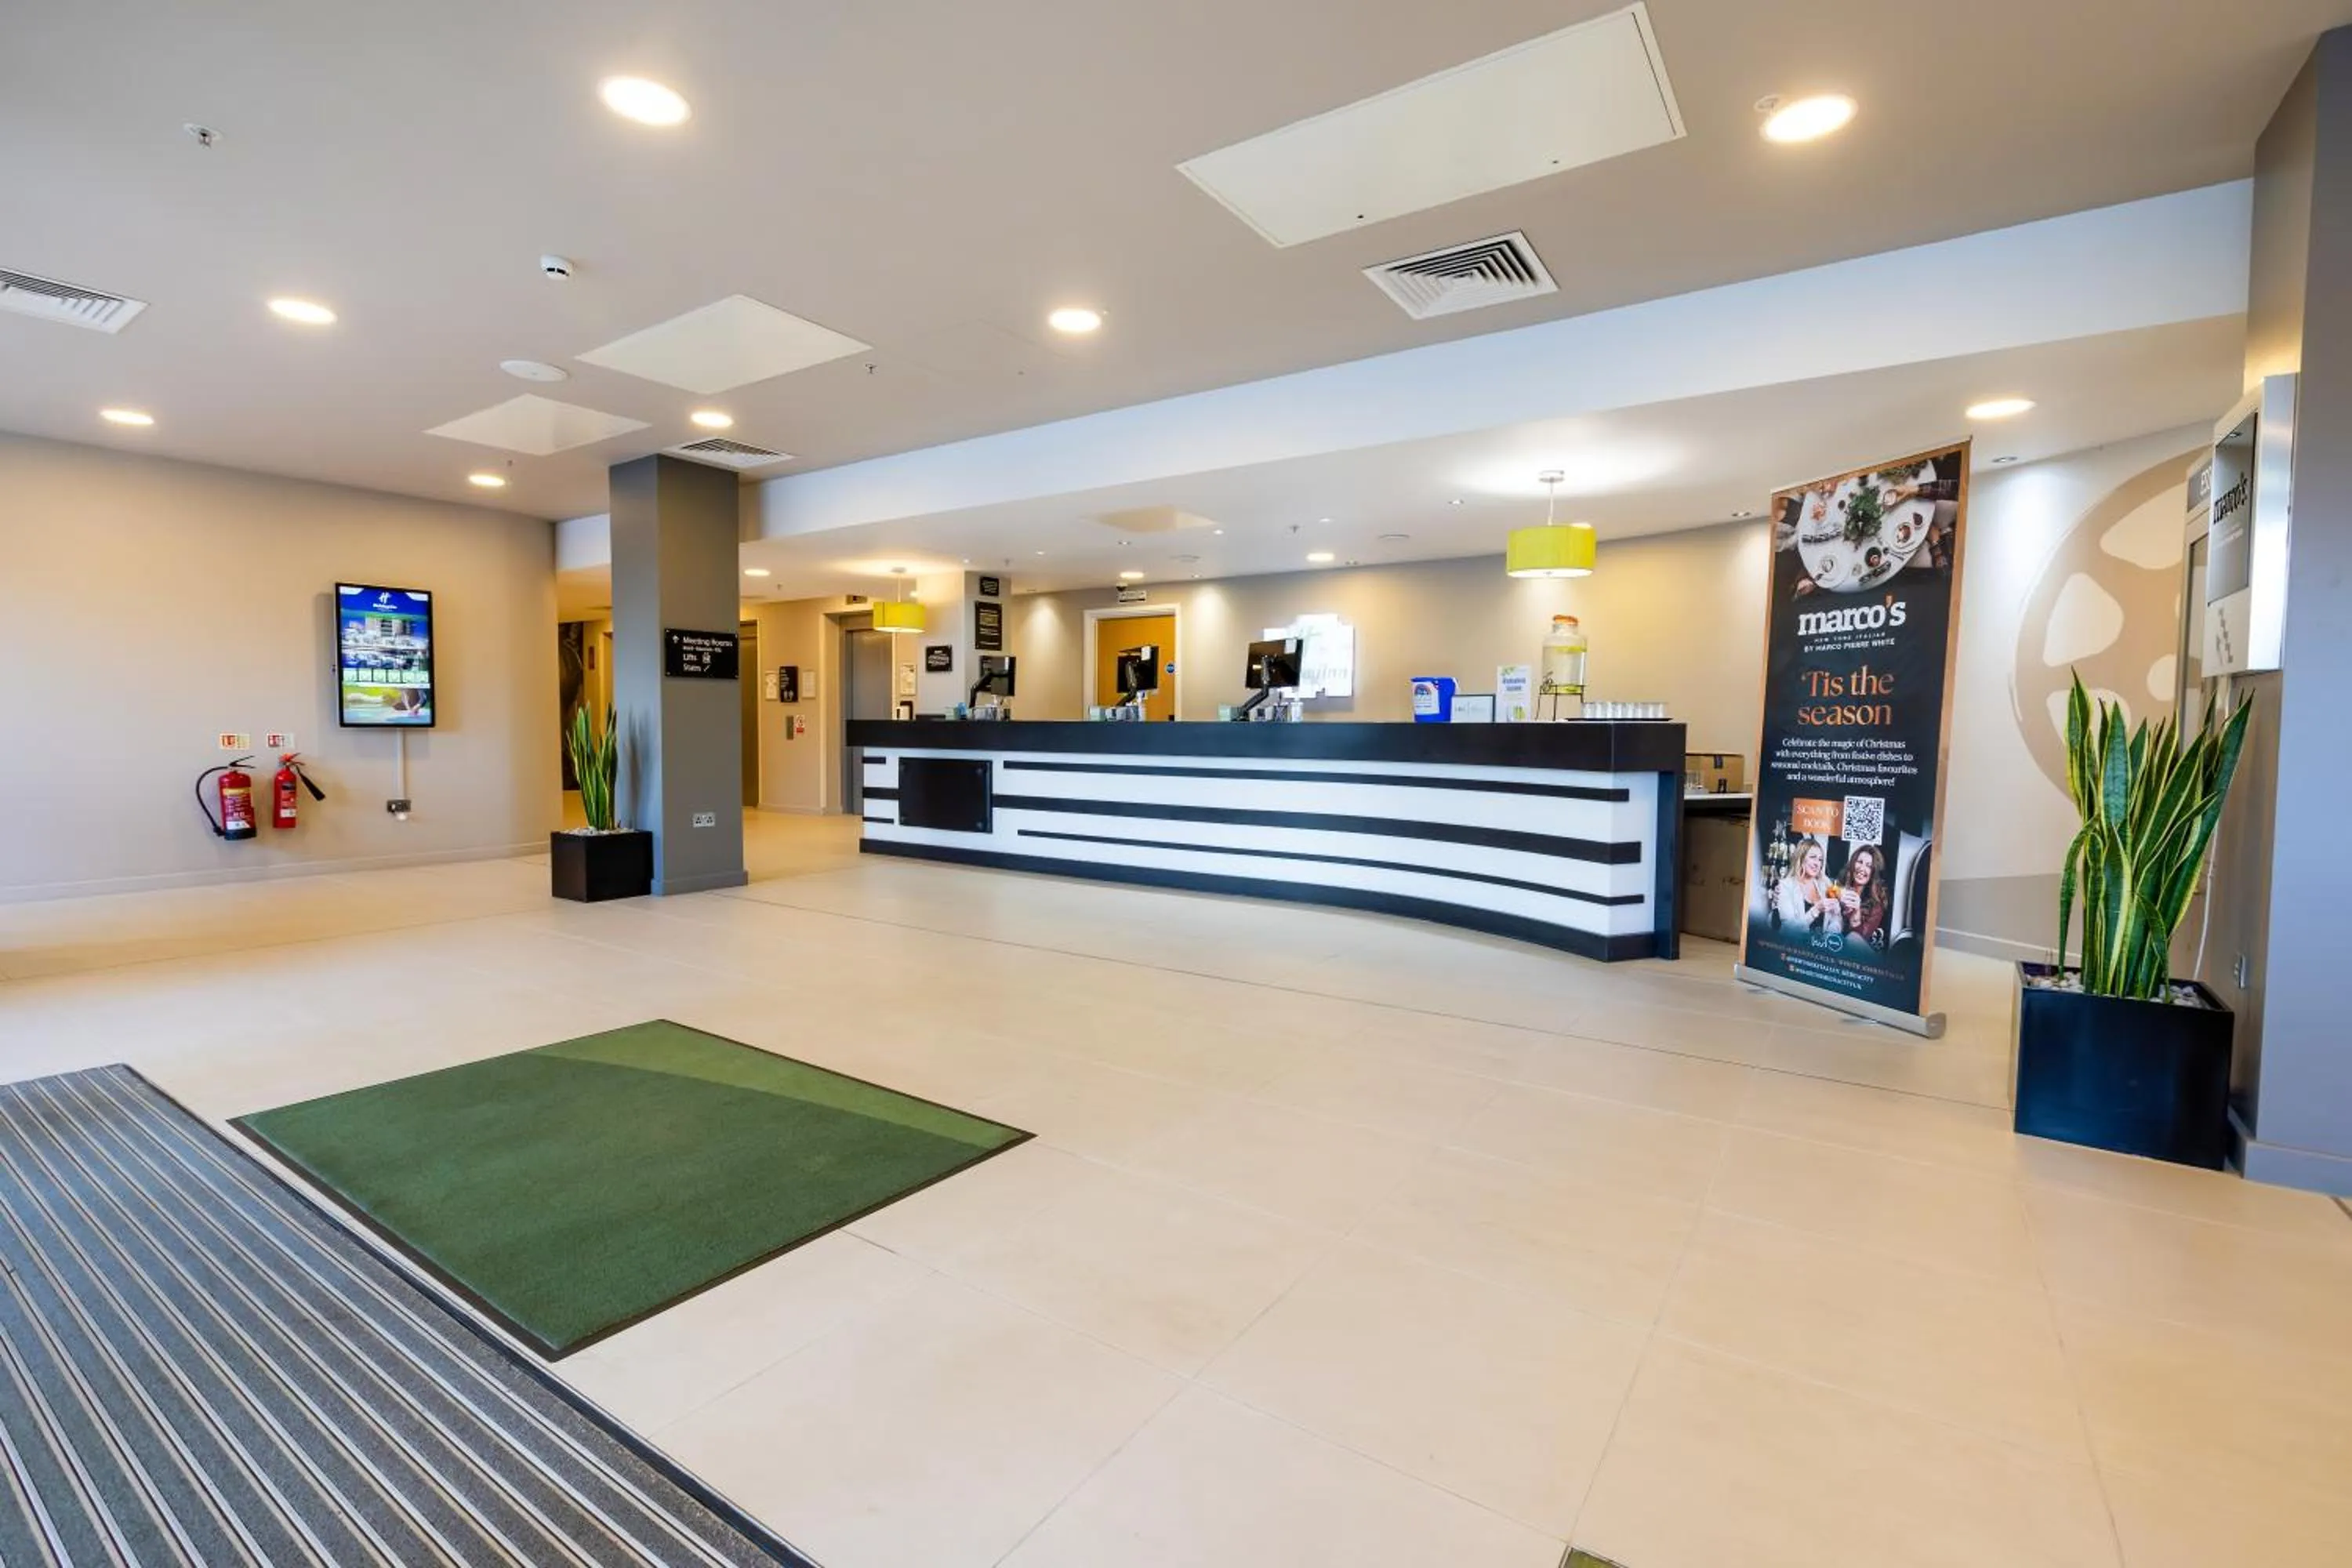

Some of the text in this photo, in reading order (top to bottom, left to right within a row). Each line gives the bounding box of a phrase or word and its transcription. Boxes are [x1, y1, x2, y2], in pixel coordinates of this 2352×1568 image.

[1798, 594, 1907, 636] marco's
[683, 636, 710, 647] Meeting
[1815, 643, 1842, 652] MARCO
[1843, 641, 1870, 650] PIERRE
[1850, 664, 1895, 696] the
[1798, 704, 1893, 725] season
[1782, 738, 1906, 750] Celebrate the magic of Christmas
[1776, 749, 1914, 762] with everything from festive dishes to
[1837, 762, 1876, 772] Christmas
[1786, 771, 1801, 781] and
[1807, 773, 1846, 783] wonderful
[1846, 775, 1895, 787] atmosphere!
